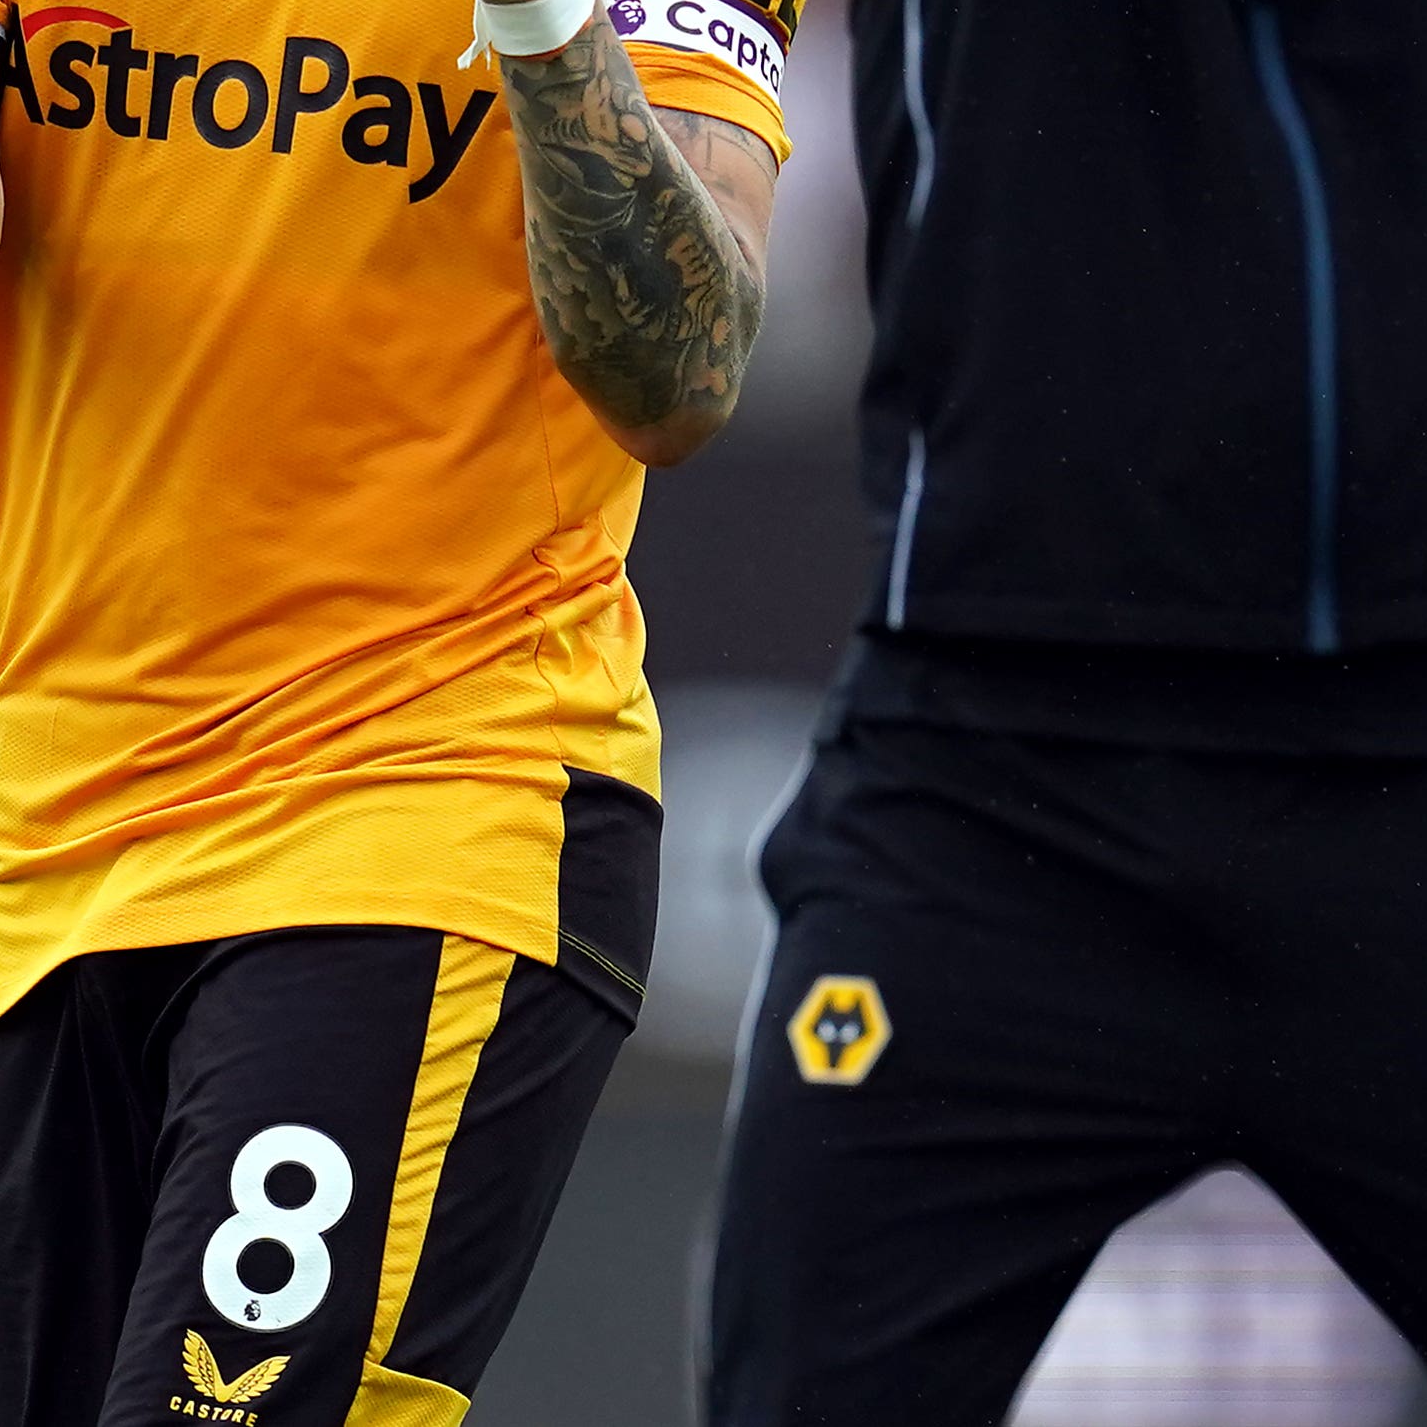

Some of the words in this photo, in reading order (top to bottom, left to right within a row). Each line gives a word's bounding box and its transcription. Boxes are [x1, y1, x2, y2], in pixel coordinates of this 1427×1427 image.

[666, 0, 782, 93] Capta
[202, 1124, 354, 1331] 8
[169, 1395, 258, 1427] CASTORE
